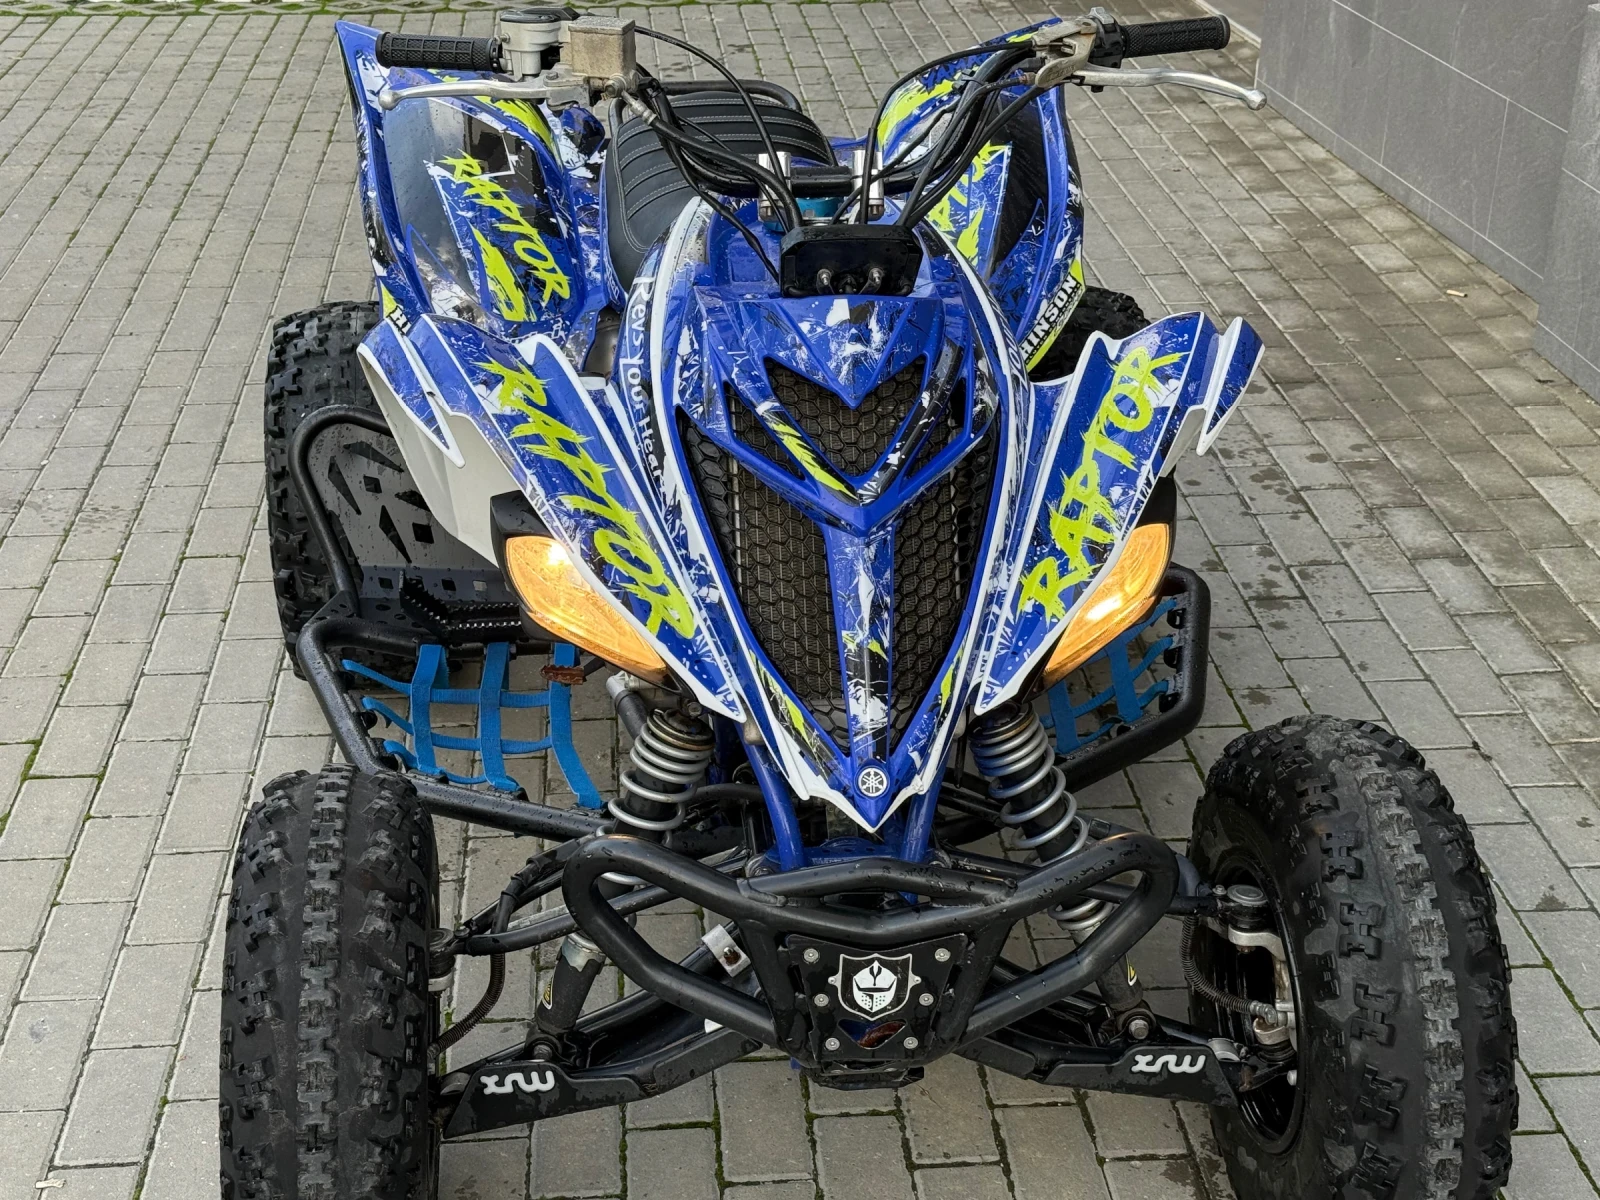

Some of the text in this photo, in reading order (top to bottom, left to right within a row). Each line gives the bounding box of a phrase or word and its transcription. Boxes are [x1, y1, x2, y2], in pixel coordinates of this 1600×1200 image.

[436, 149, 571, 306] RAPTOR
[626, 277, 658, 352] Revs
[1019, 274, 1077, 361] HINSON
[619, 347, 647, 421] Your
[472, 359, 695, 640] RAPTOR
[1018, 347, 1188, 624] RAPTOR
